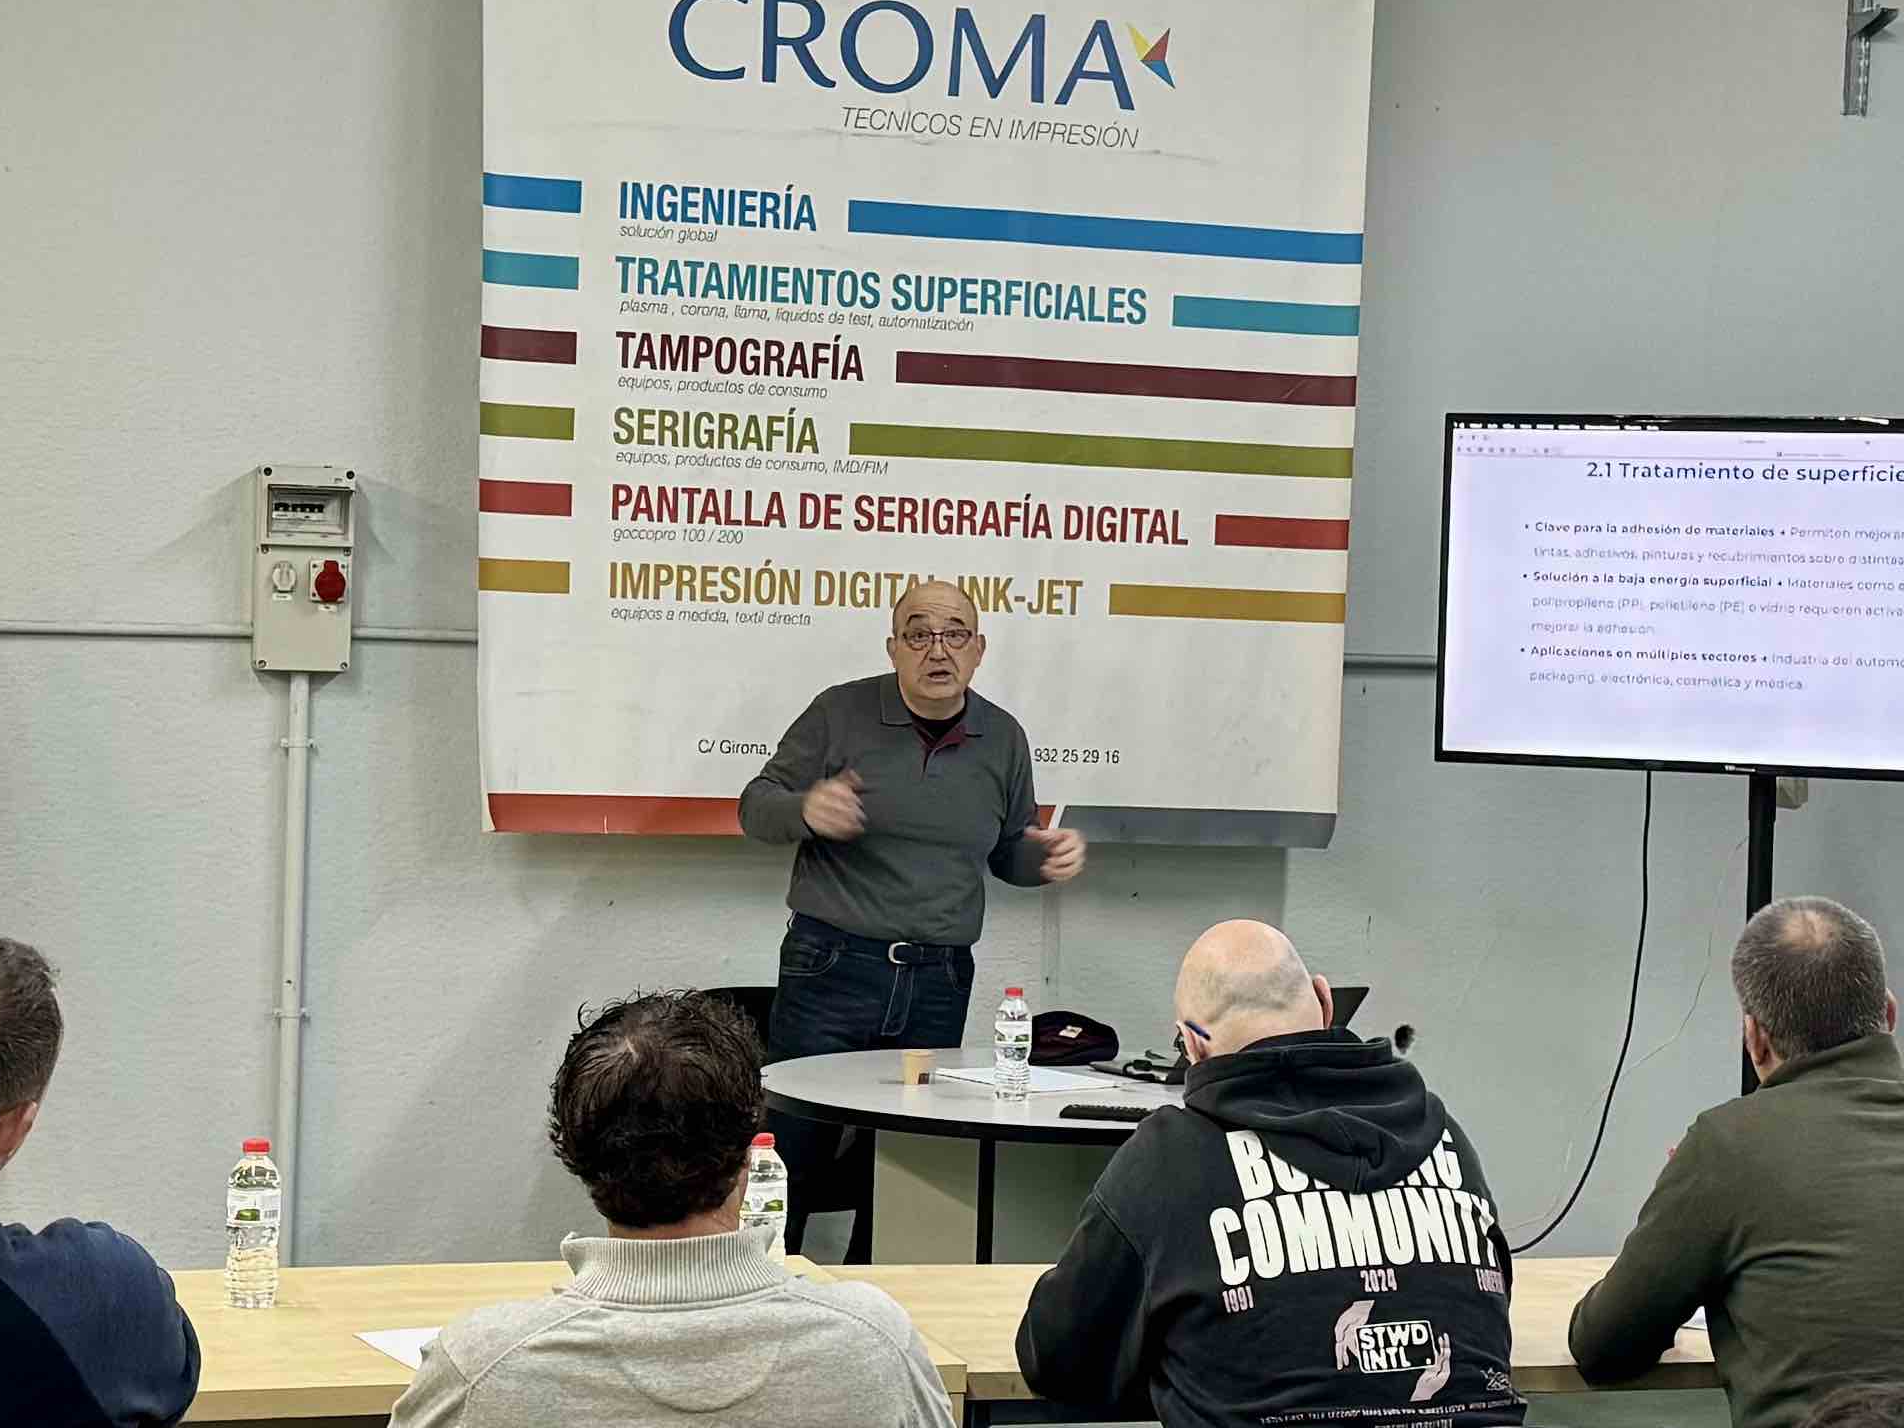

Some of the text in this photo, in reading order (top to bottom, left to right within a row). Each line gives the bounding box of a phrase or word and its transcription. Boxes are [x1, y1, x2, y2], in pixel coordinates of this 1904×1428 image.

[841, 105, 1139, 149] TECNICOS EN IMPRESIÓN
[619, 183, 817, 232] INGENIERÍA
[620, 224, 718, 244] solución global
[615, 256, 1147, 325] TRATAMIENTOS SUPERFICIALES
[680, 304, 728, 319] corona,
[828, 310, 846, 325] de
[848, 312, 875, 328] test,
[878, 316, 974, 332] automatización
[616, 331, 864, 382] TAMPOGRAFÍA
[618, 374, 827, 399] equipos, productos de consumo
[613, 406, 819, 454] SERIGRAFÍA
[615, 450, 889, 475] equipos, productos de consumo, IMD/FIM
[1586, 462, 1612, 478] 2.1
[1618, 462, 1755, 480] Tratamiento
[1762, 464, 1790, 481] de
[611, 484, 1189, 546] PANTALLA DE SERIGRAFÍA DIGITAL
[613, 528, 676, 543] goccopro
[682, 528, 706, 542] 100
[716, 530, 744, 545] 200
[1574, 525, 1602, 535] para
[1606, 523, 1617, 533] la
[1622, 524, 1681, 535] adhesión
[1685, 524, 1701, 535] de
[1705, 525, 1775, 536] materiales
[609, 559, 801, 606] IMPRESIÓN
[1533, 571, 1588, 583] Solución
[1604, 573, 1614, 583] la
[1618, 573, 1646, 586] baja
[1703, 576, 1772, 588] superficial
[611, 607, 664, 621] equipos
[665, 612, 675, 621] a
[698, 739, 1120, 764] C/ Girona, 932 25 29 16
[1209, 1186, 1496, 1286] COMMUNITY
[1222, 1268, 1397, 1313] 1991 2024
[1359, 1324, 1429, 1350] STWD
